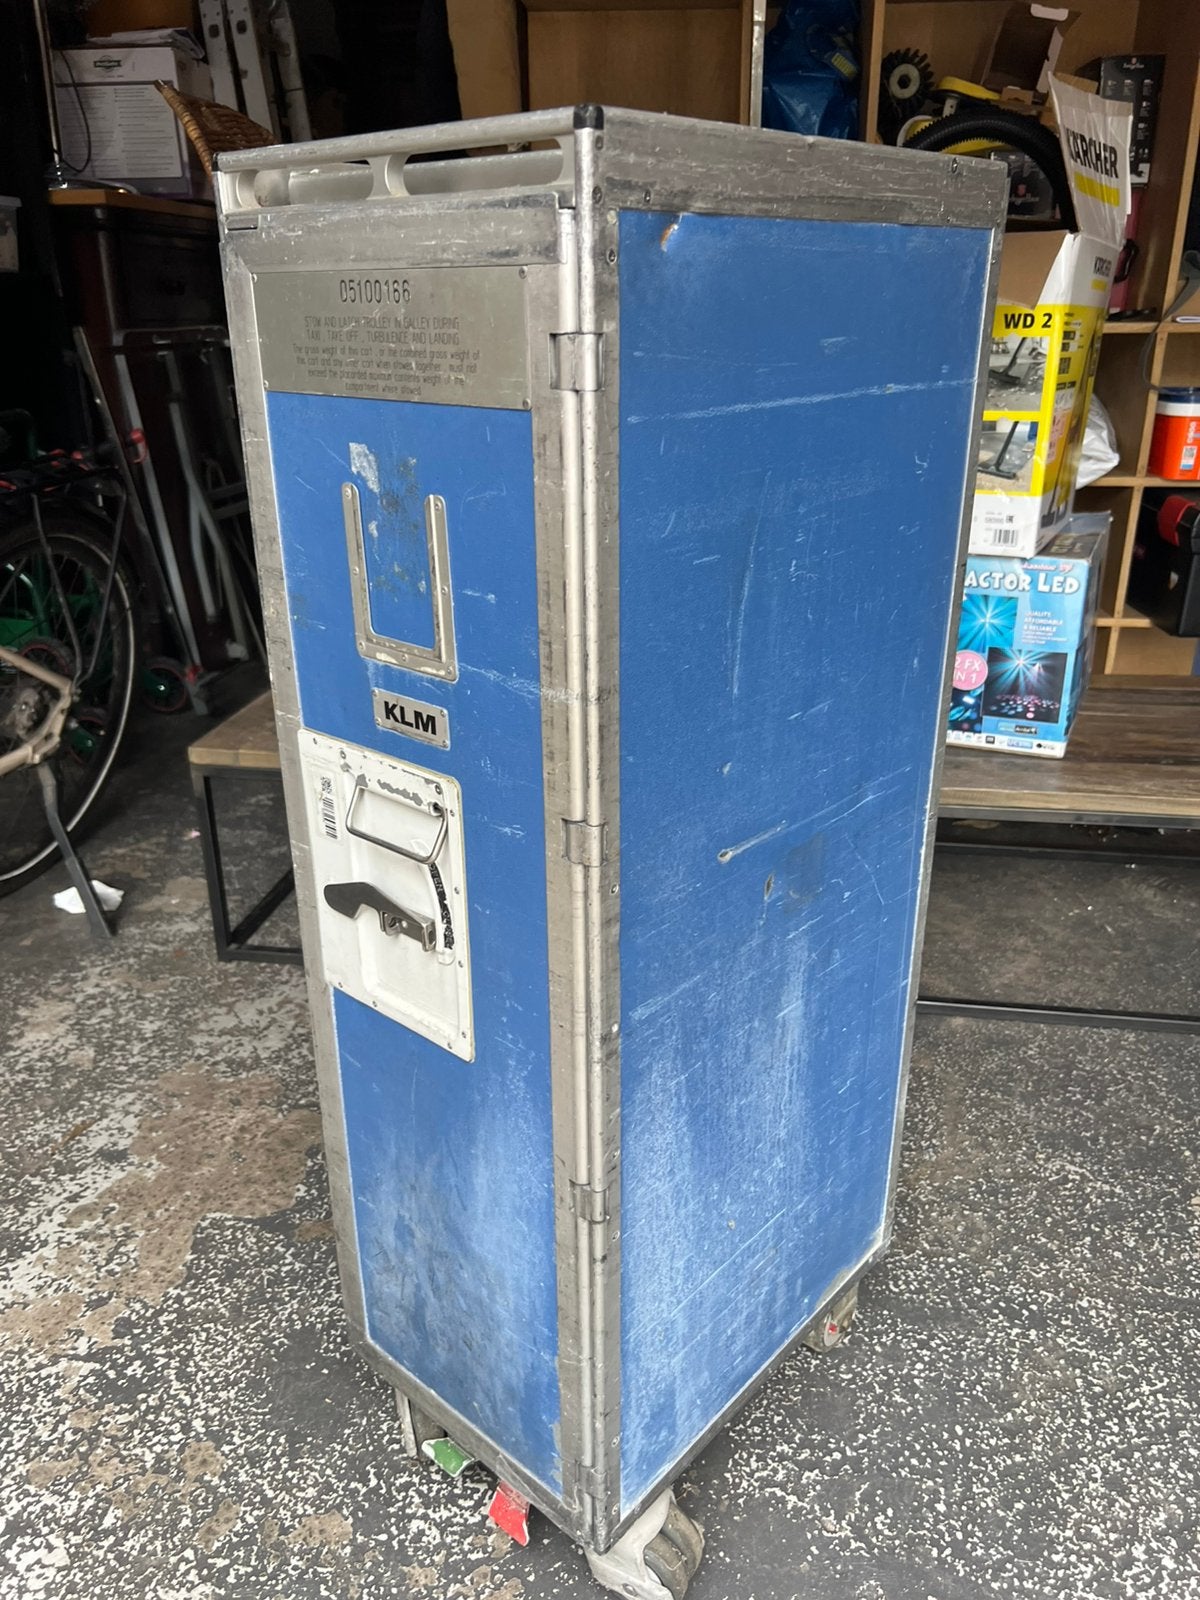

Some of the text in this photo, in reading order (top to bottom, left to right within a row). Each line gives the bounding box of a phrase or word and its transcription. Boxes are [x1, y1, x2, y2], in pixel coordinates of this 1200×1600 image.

[340, 279, 410, 304] 05100166
[304, 316, 321, 328] STOW
[325, 316, 336, 328] AND
[361, 316, 391, 330] TROLLEY
[403, 317, 429, 330] GALLEY
[432, 317, 459, 330] DURING
[1004, 313, 1035, 329] WD
[1041, 313, 1053, 328] 2
[328, 331, 343, 343] TAKE
[367, 331, 409, 344] TURBULENCE
[412, 333, 425, 345] AND
[428, 333, 459, 346] LANDING
[429, 351, 447, 362] gross
[450, 350, 470, 362] weight
[1037, 572, 1080, 595] LED
[964, 658, 981, 672] FX
[970, 673, 976, 684] 1
[384, 701, 437, 736] KLM
